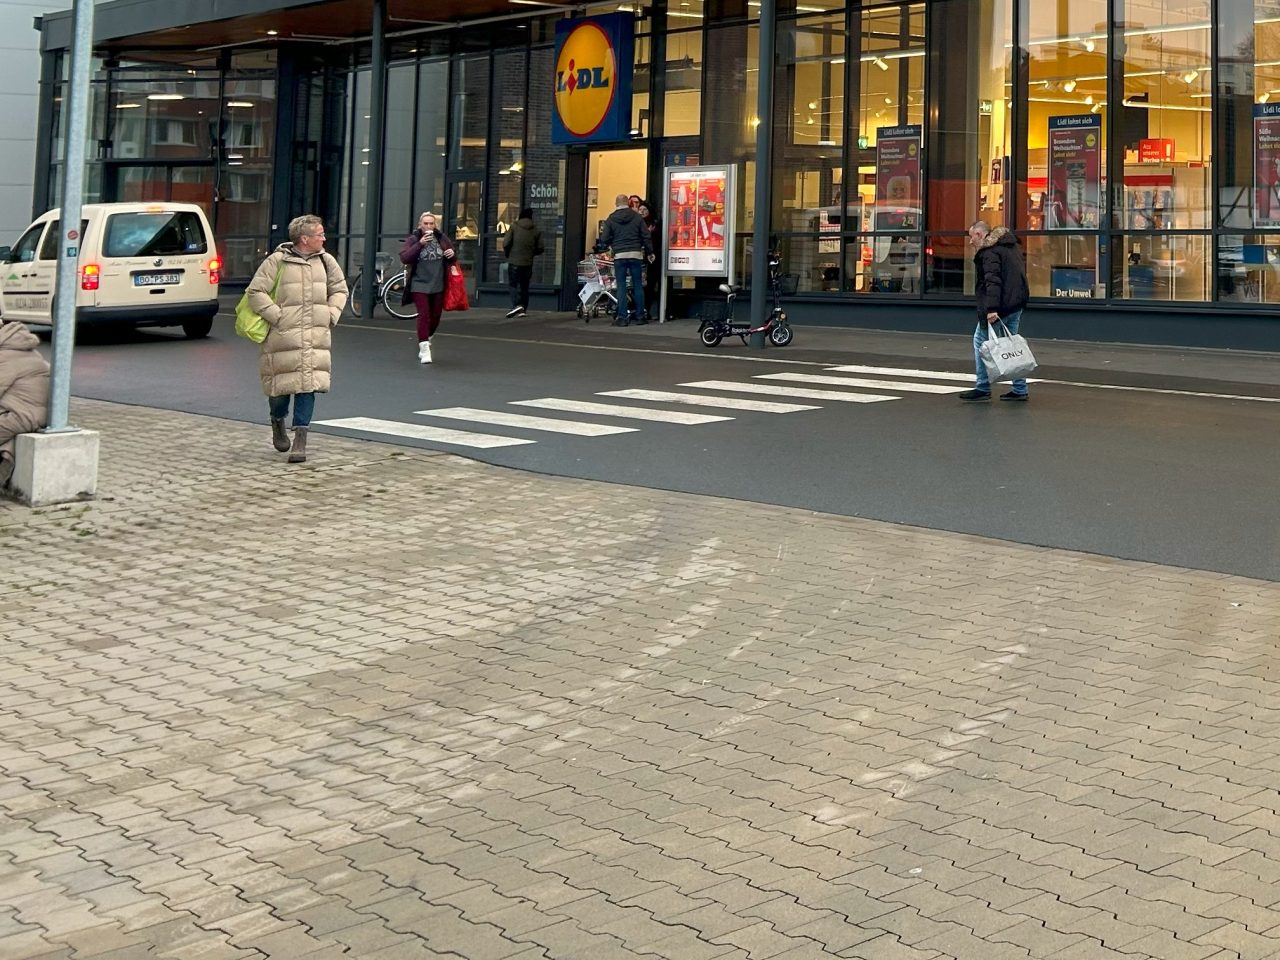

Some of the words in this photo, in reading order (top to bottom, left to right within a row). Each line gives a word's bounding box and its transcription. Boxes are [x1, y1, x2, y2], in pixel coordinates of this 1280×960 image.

[1263, 106, 1275, 114] Lidl
[1057, 118, 1067, 126] Lidl
[530, 183, 558, 198] Schön
[139, 275, 149, 284] BO
[1055, 288, 1068, 297] Der
[1068, 288, 1092, 298] Umwel
[1001, 349, 1024, 360] ONLY
